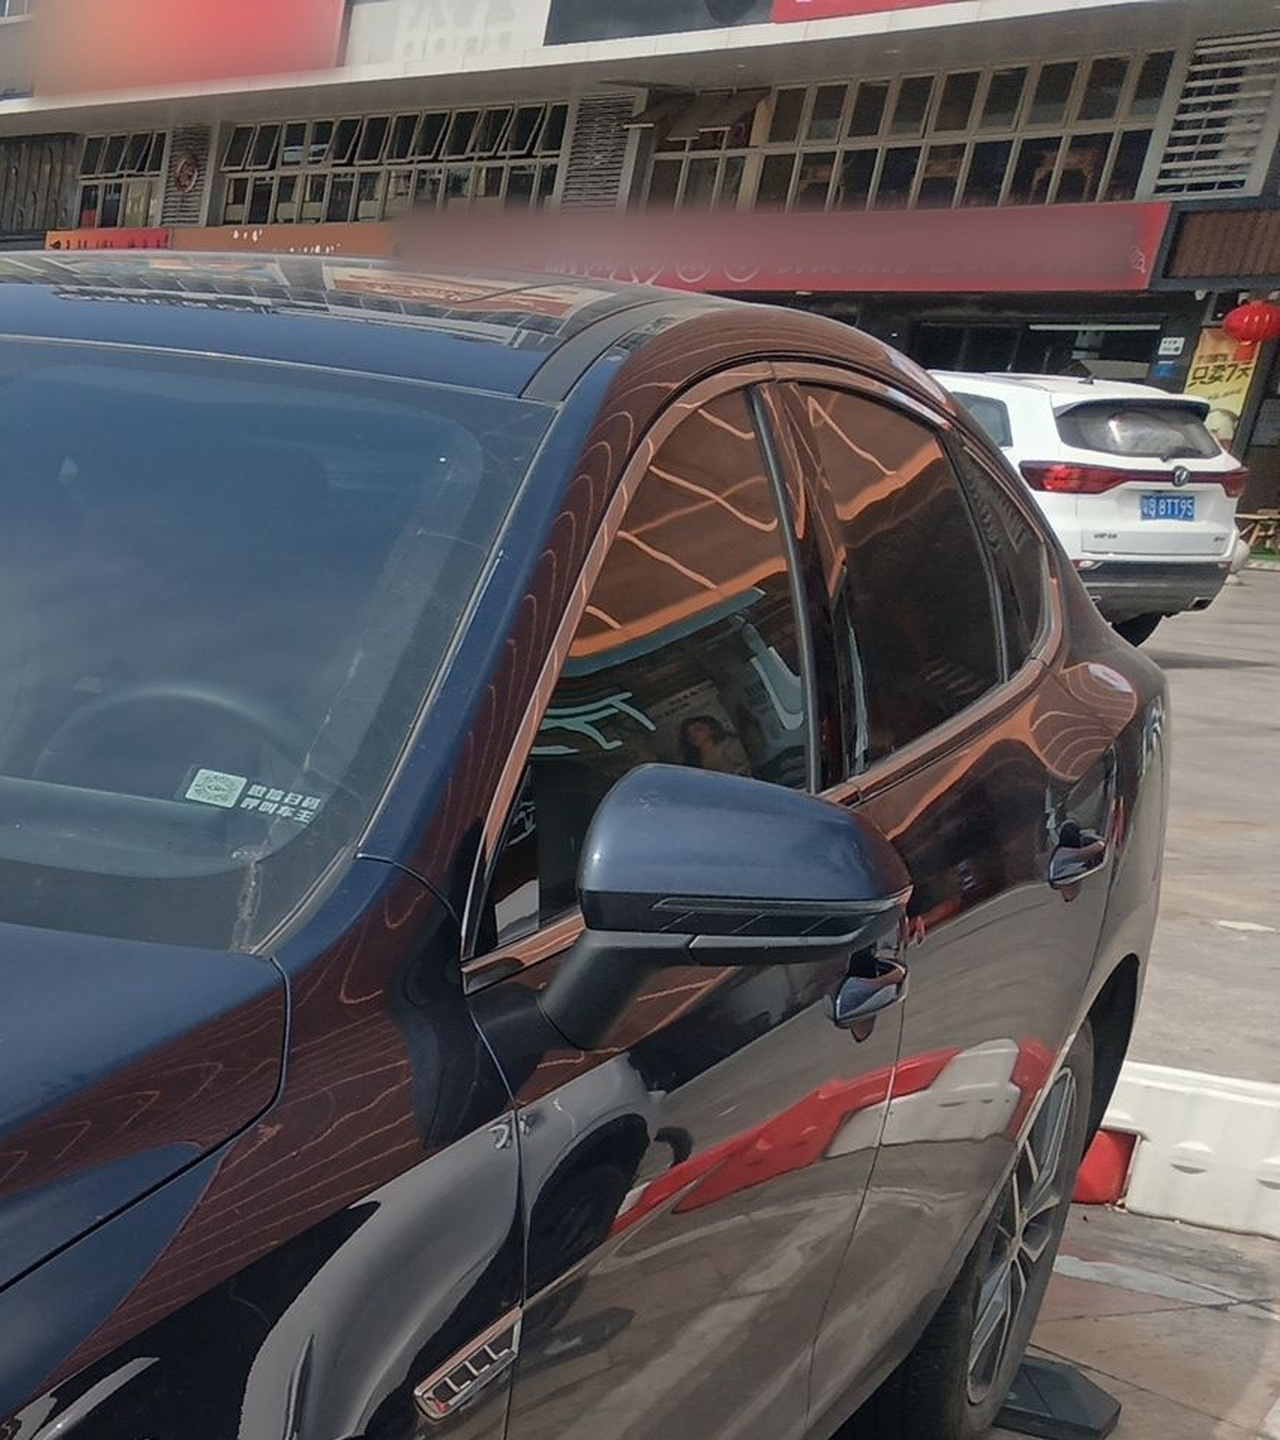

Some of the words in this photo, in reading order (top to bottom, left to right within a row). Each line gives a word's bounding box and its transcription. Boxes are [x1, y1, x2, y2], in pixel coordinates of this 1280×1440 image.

[247, 784, 321, 810] 微信扫码
[240, 797, 315, 824] 呼叫车主
